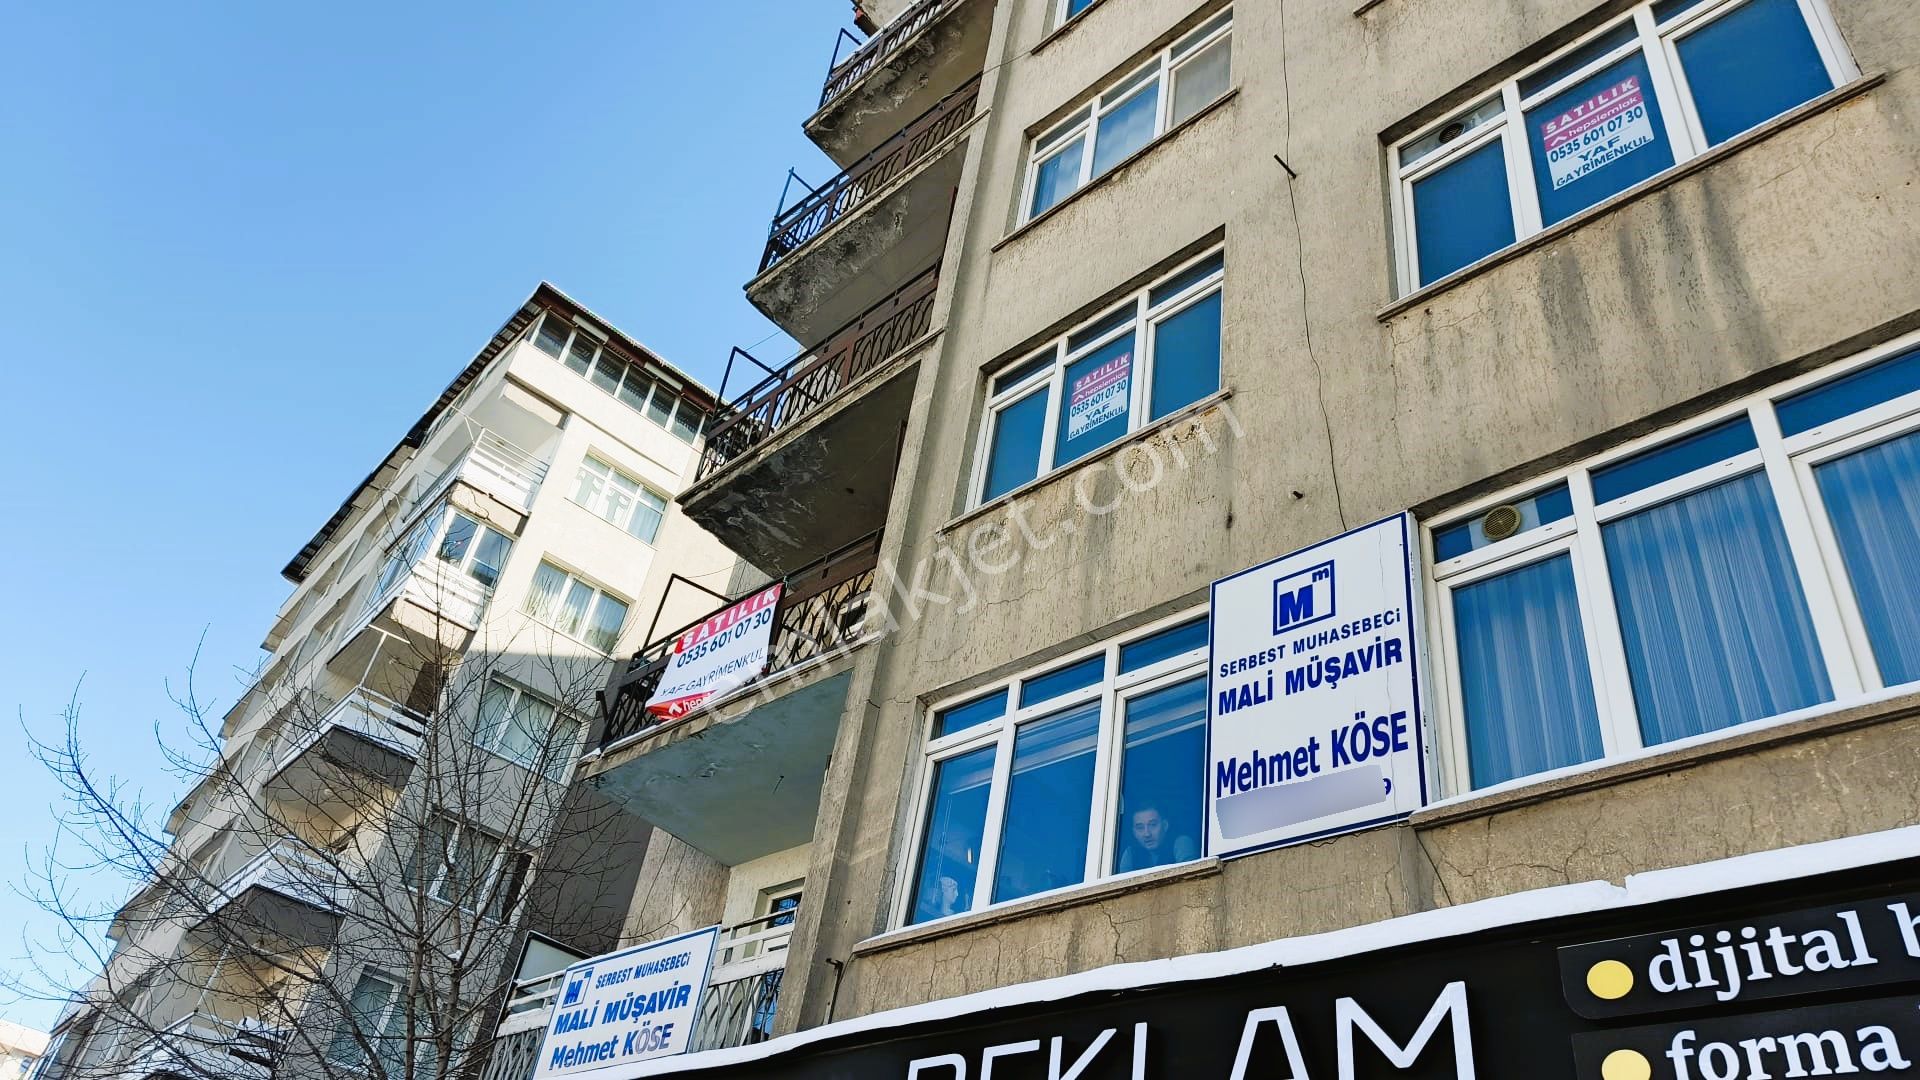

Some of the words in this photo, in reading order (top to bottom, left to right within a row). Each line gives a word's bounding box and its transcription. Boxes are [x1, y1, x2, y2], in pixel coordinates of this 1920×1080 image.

[1547, 79, 1635, 133] SATILIK
[1550, 139, 1580, 162] 0535
[1583, 127, 1605, 146] 601
[1607, 115, 1623, 132] 07
[1625, 106, 1643, 123] 30
[1578, 135, 1620, 161] YAF
[1072, 400, 1089, 417] 0535
[1116, 379, 1126, 393] 30
[1076, 354, 1129, 391] SATILIK
[1085, 402, 1110, 420] YAF
[677, 641, 708, 668] 0535
[709, 630, 732, 652] 601
[734, 618, 752, 639] 07
[753, 607, 772, 630] 30
[682, 588, 776, 647] SATILIK
[685, 647, 764, 691] GAYRİMENKUL
[1218, 670, 1273, 715] MALİ
[1285, 636, 1403, 696] MÜŞAVİR
[1219, 644, 1286, 678] SERBEST
[1216, 736, 1320, 798] Mehmet
[1331, 710, 1409, 768] KÖSE
[595, 968, 633, 989] SERBEST
[1648, 910, 1879, 1001] dijital
[1886, 902, 1920, 958] b
[553, 1000, 599, 1036] MALİ
[602, 980, 692, 1023] MÜŞAVİR
[549, 1035, 619, 1071] Mehmet
[622, 1020, 674, 1056] KÖSE
[1665, 1024, 1912, 1080] forma
